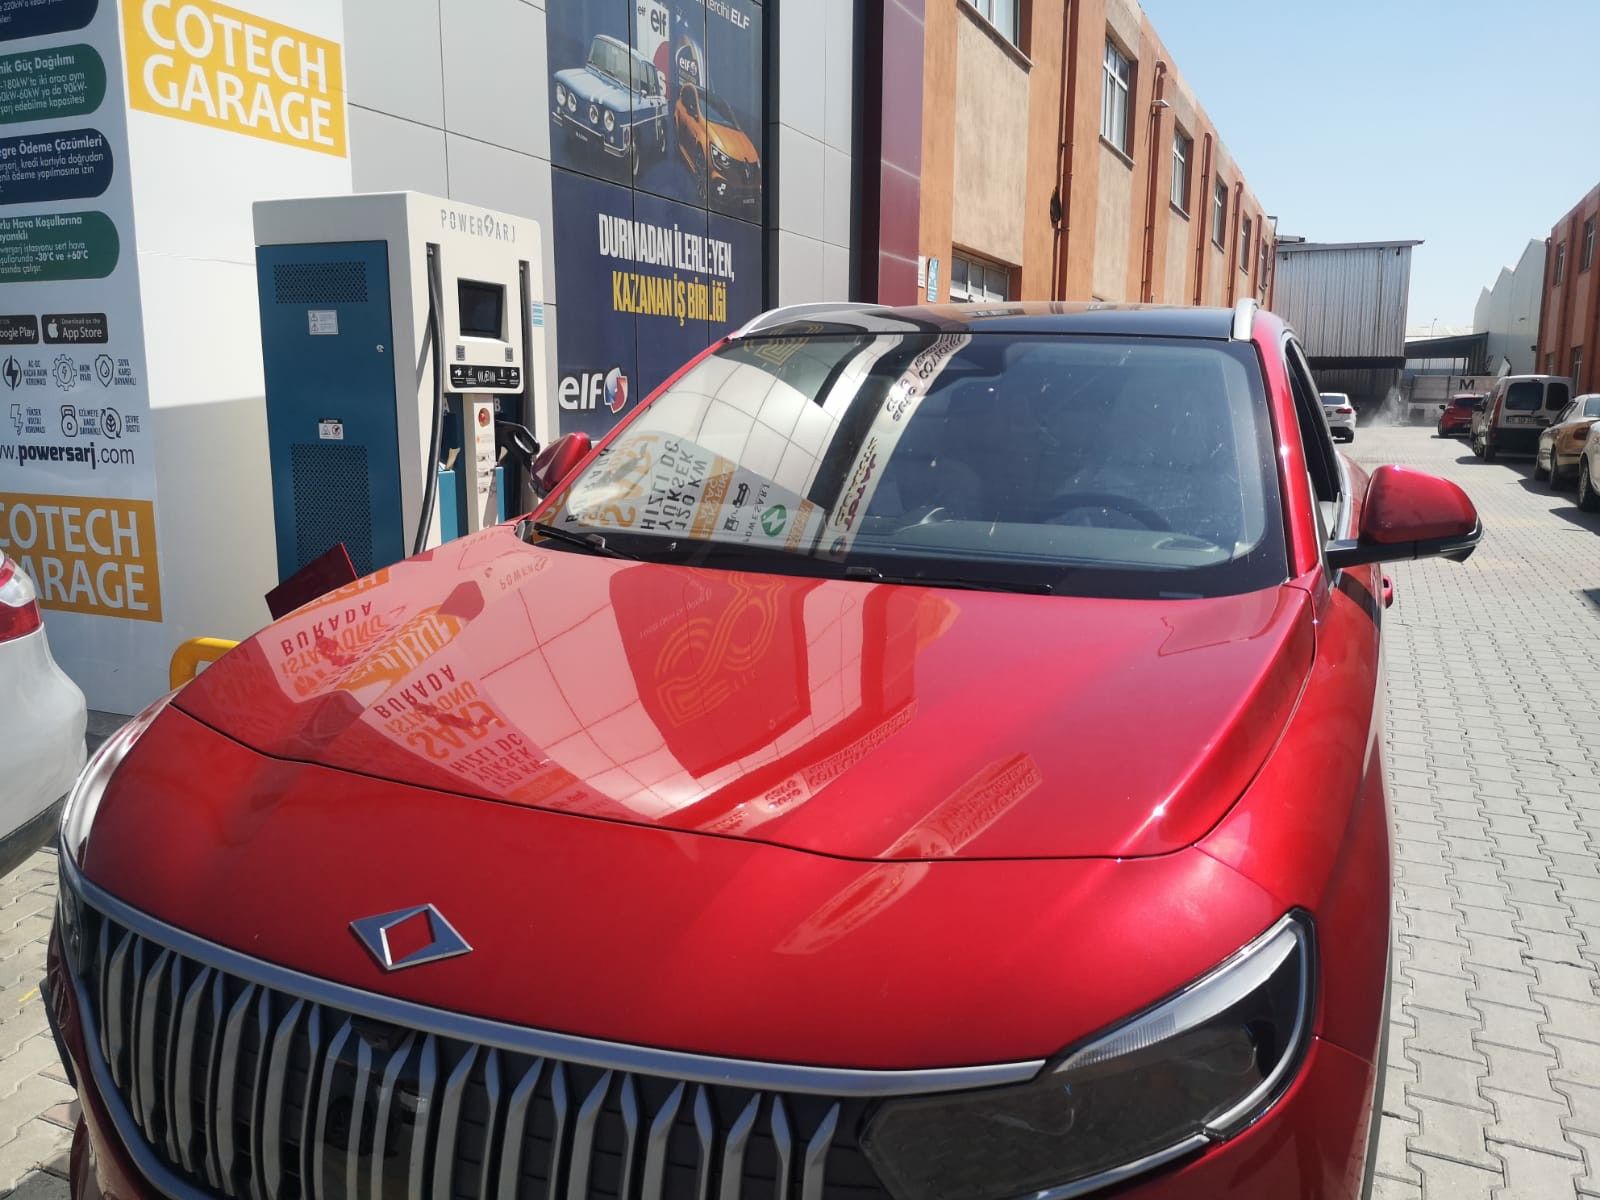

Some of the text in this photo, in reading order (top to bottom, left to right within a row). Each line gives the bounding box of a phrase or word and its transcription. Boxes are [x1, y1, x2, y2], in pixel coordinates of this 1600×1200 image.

[651, 9, 667, 37] elf
[731, 8, 750, 30] ELF
[142, 0, 327, 93] COTECH
[14, 60, 33, 74] Güç
[35, 54, 75, 71] Dağılımı
[680, 57, 690, 71] elf
[143, 54, 334, 146] GARAGE
[19, 140, 53, 155] Ödeme
[54, 135, 103, 154] Çözümleri
[12, 219, 34, 229] Hava
[35, 215, 83, 230] Koşullarına
[598, 213, 735, 283] DURMADAN İLERLEYEN,
[612, 271, 727, 327] KAZANAN İŞ BİRLİĞİ
[19, 326, 35, 340] Play
[62, 326, 103, 341] App Store
[558, 373, 603, 410] elf
[1459, 378, 1475, 391] M
[20, 555, 149, 612] ARAGE
